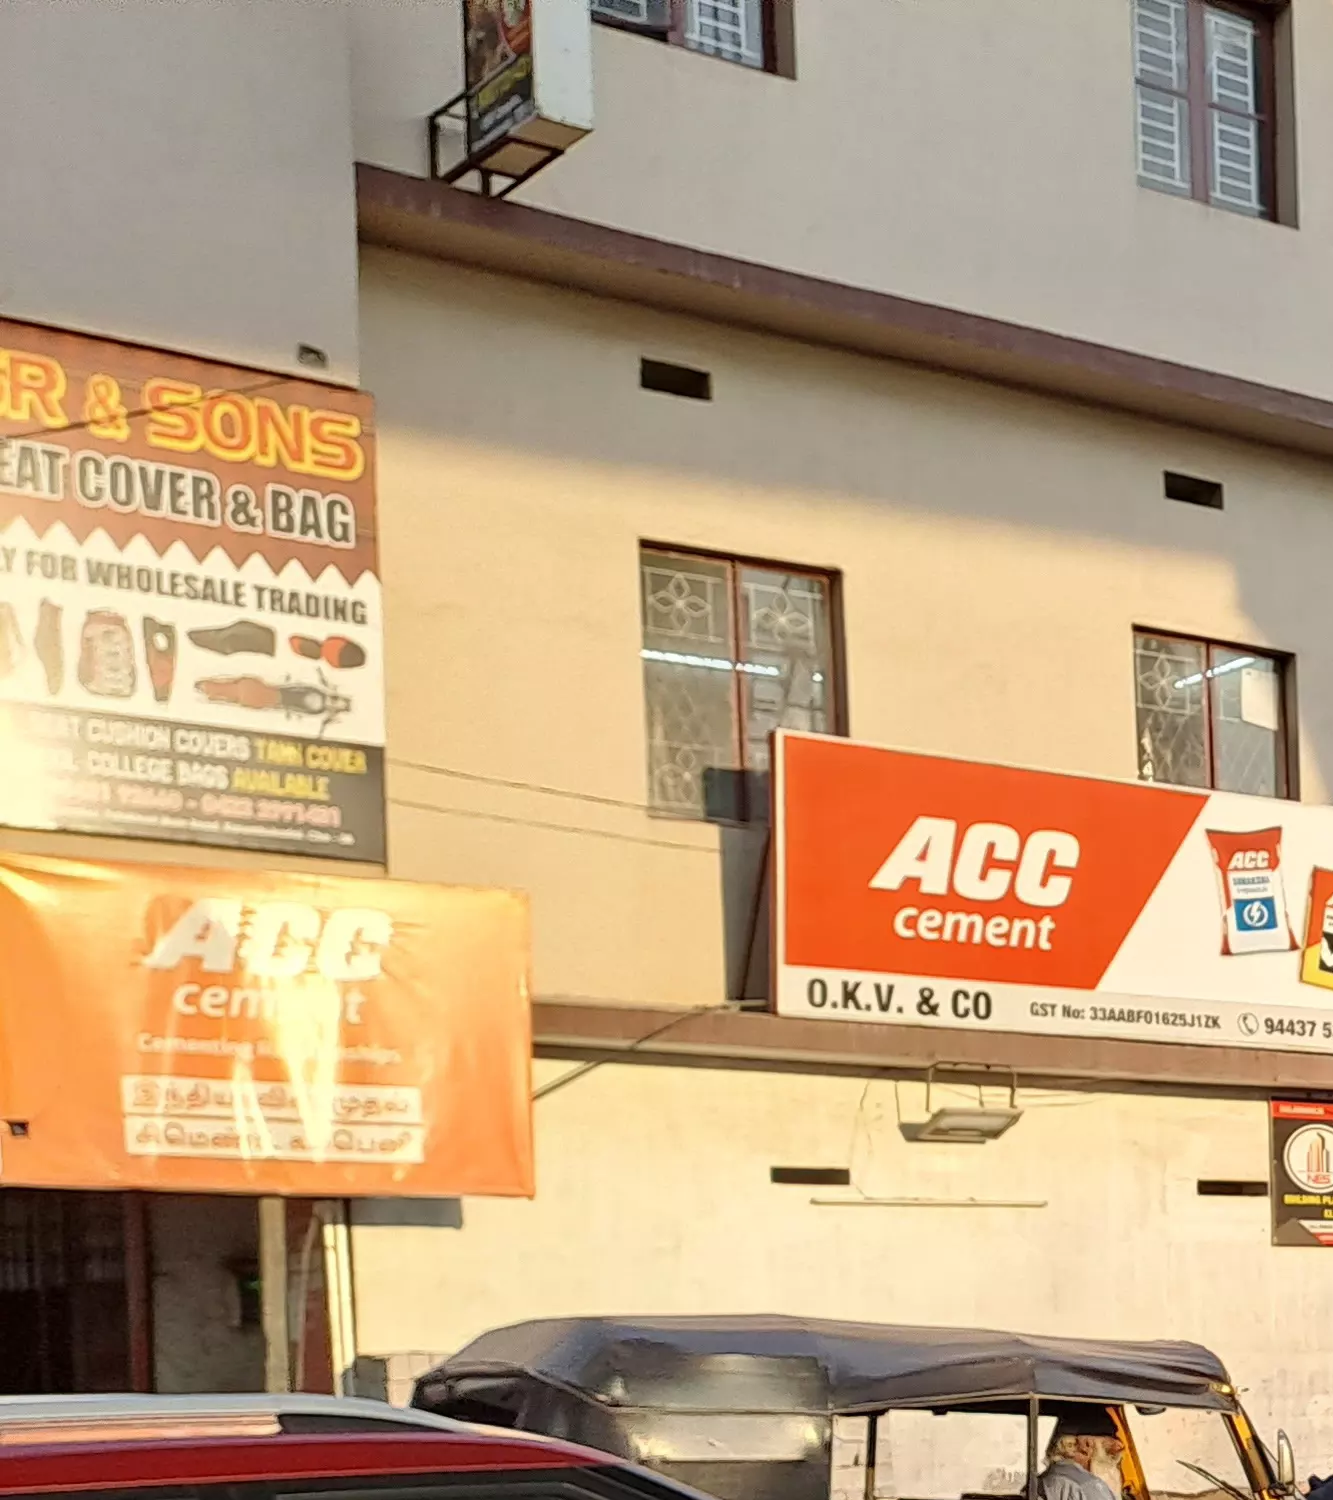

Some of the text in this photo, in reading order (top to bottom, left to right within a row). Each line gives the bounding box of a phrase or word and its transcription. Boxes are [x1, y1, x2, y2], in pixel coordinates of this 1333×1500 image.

[0, 350, 365, 481] R & SONS
[75, 453, 221, 524] COVER
[226, 484, 262, 534] &
[266, 485, 356, 548] BAG
[26, 550, 77, 581] FOR
[87, 560, 247, 607] WHOLESALE
[255, 585, 367, 625] TRADING
[868, 815, 1079, 907] ACC
[1228, 851, 1270, 869] ACC
[141, 898, 393, 982] ACC
[895, 905, 1055, 950] cement
[172, 981, 364, 1024] cemt
[807, 978, 992, 1020] O.K.V. & CO
[1030, 1002, 1057, 1018] GST
[1062, 1004, 1085, 1020] No:
[1264, 1017, 1317, 1038] 94437
